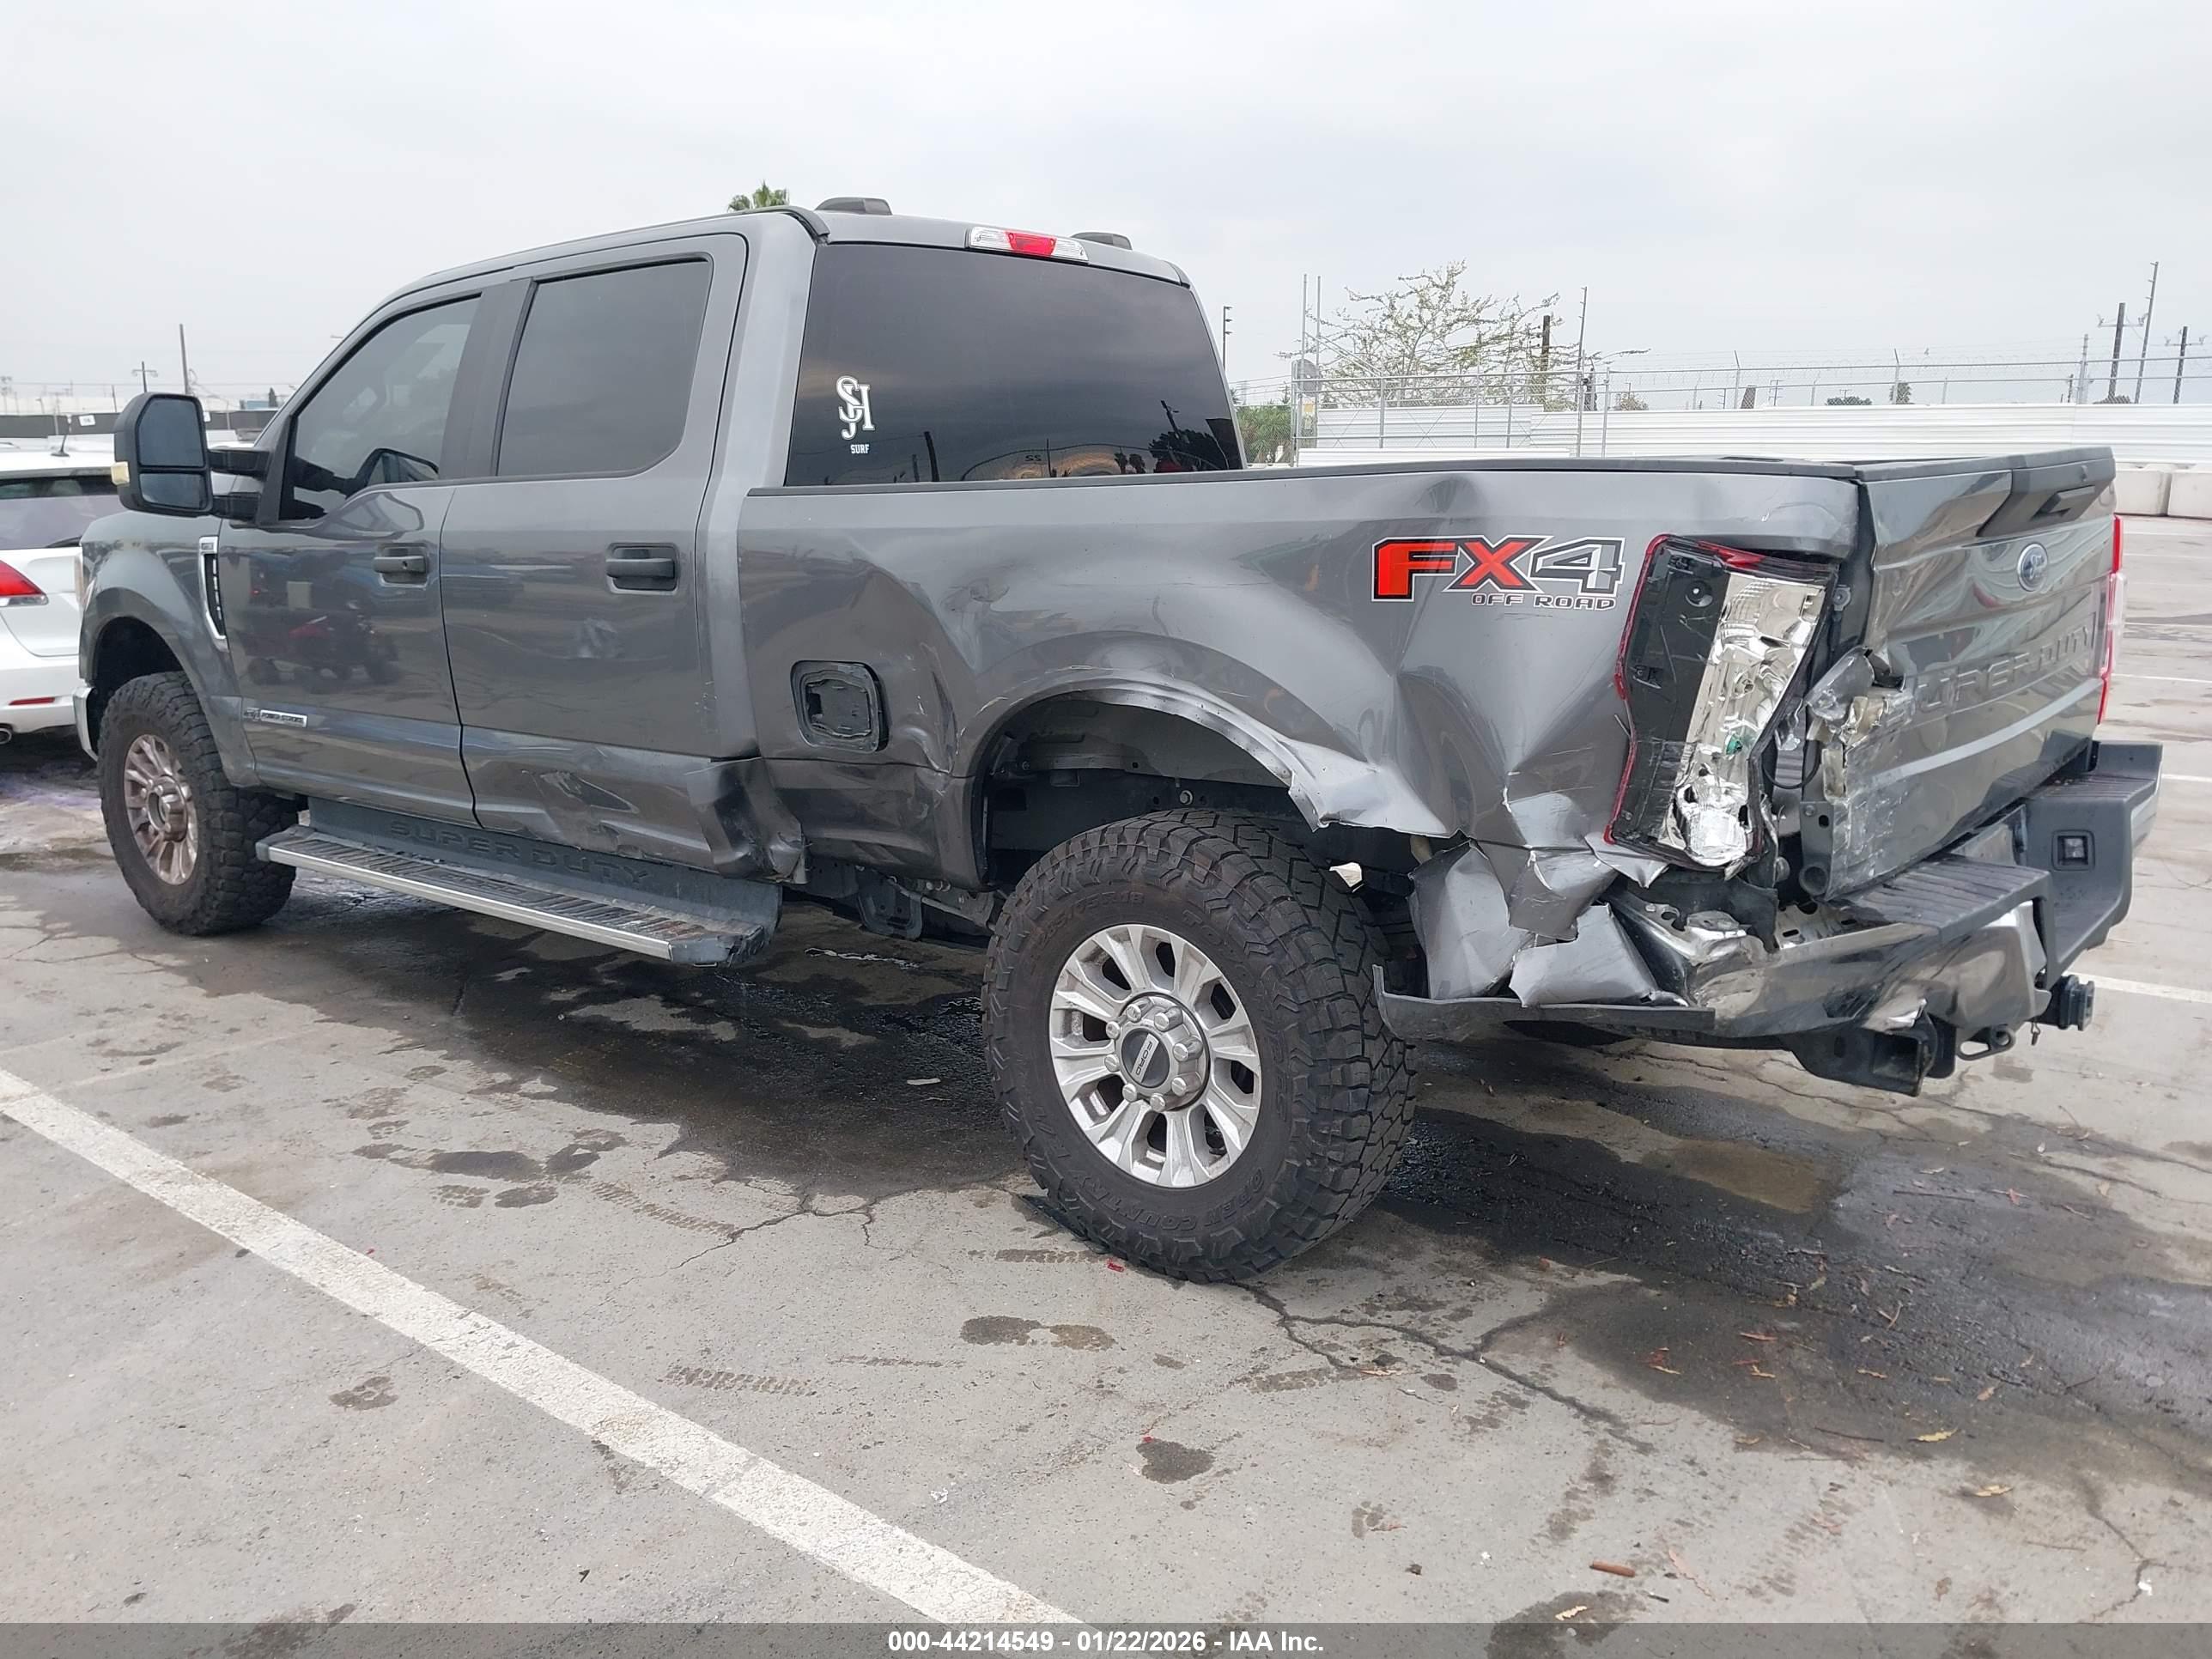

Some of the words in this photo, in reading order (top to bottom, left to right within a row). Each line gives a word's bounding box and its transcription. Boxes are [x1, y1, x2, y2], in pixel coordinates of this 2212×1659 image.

[850, 444, 870, 454] SURF
[1371, 534, 1626, 602] FX4
[1471, 592, 1524, 606] OFF
[1534, 594, 1617, 611] ROAD
[390, 821, 520, 860] SUPER
[532, 848, 649, 883] DUTY
[1135, 1041, 1153, 1076] FORD
[1204, 1167, 1263, 1227] OPEN
